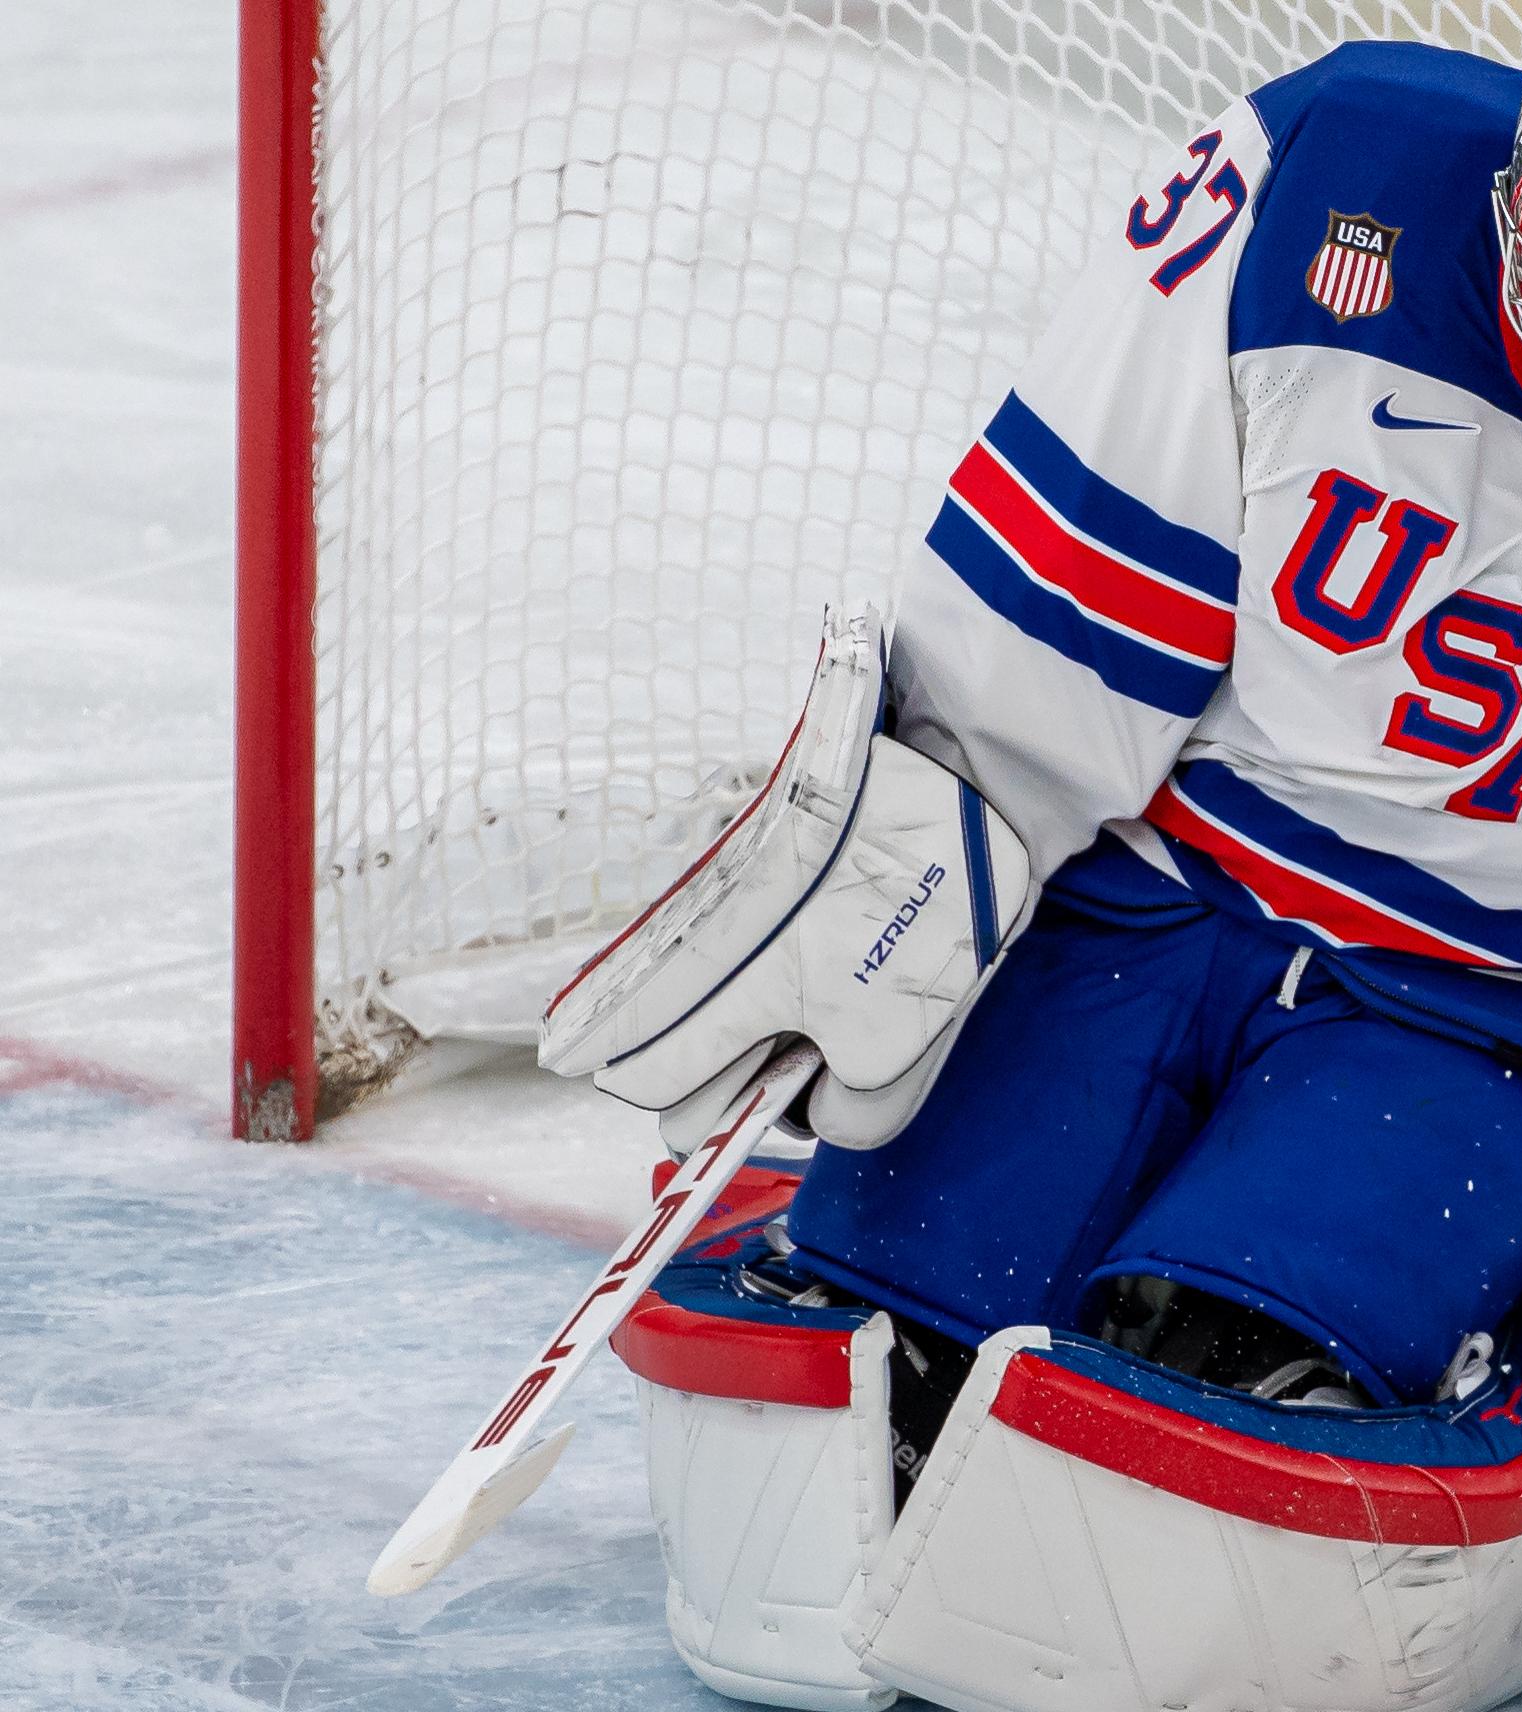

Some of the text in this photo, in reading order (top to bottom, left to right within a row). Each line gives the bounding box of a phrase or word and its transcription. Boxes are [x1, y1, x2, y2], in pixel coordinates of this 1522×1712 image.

[1126, 129, 1248, 298] 37
[1338, 221, 1382, 252] USA
[853, 862, 947, 986] HZRDUS
[471, 1086, 767, 1453] TRUE
